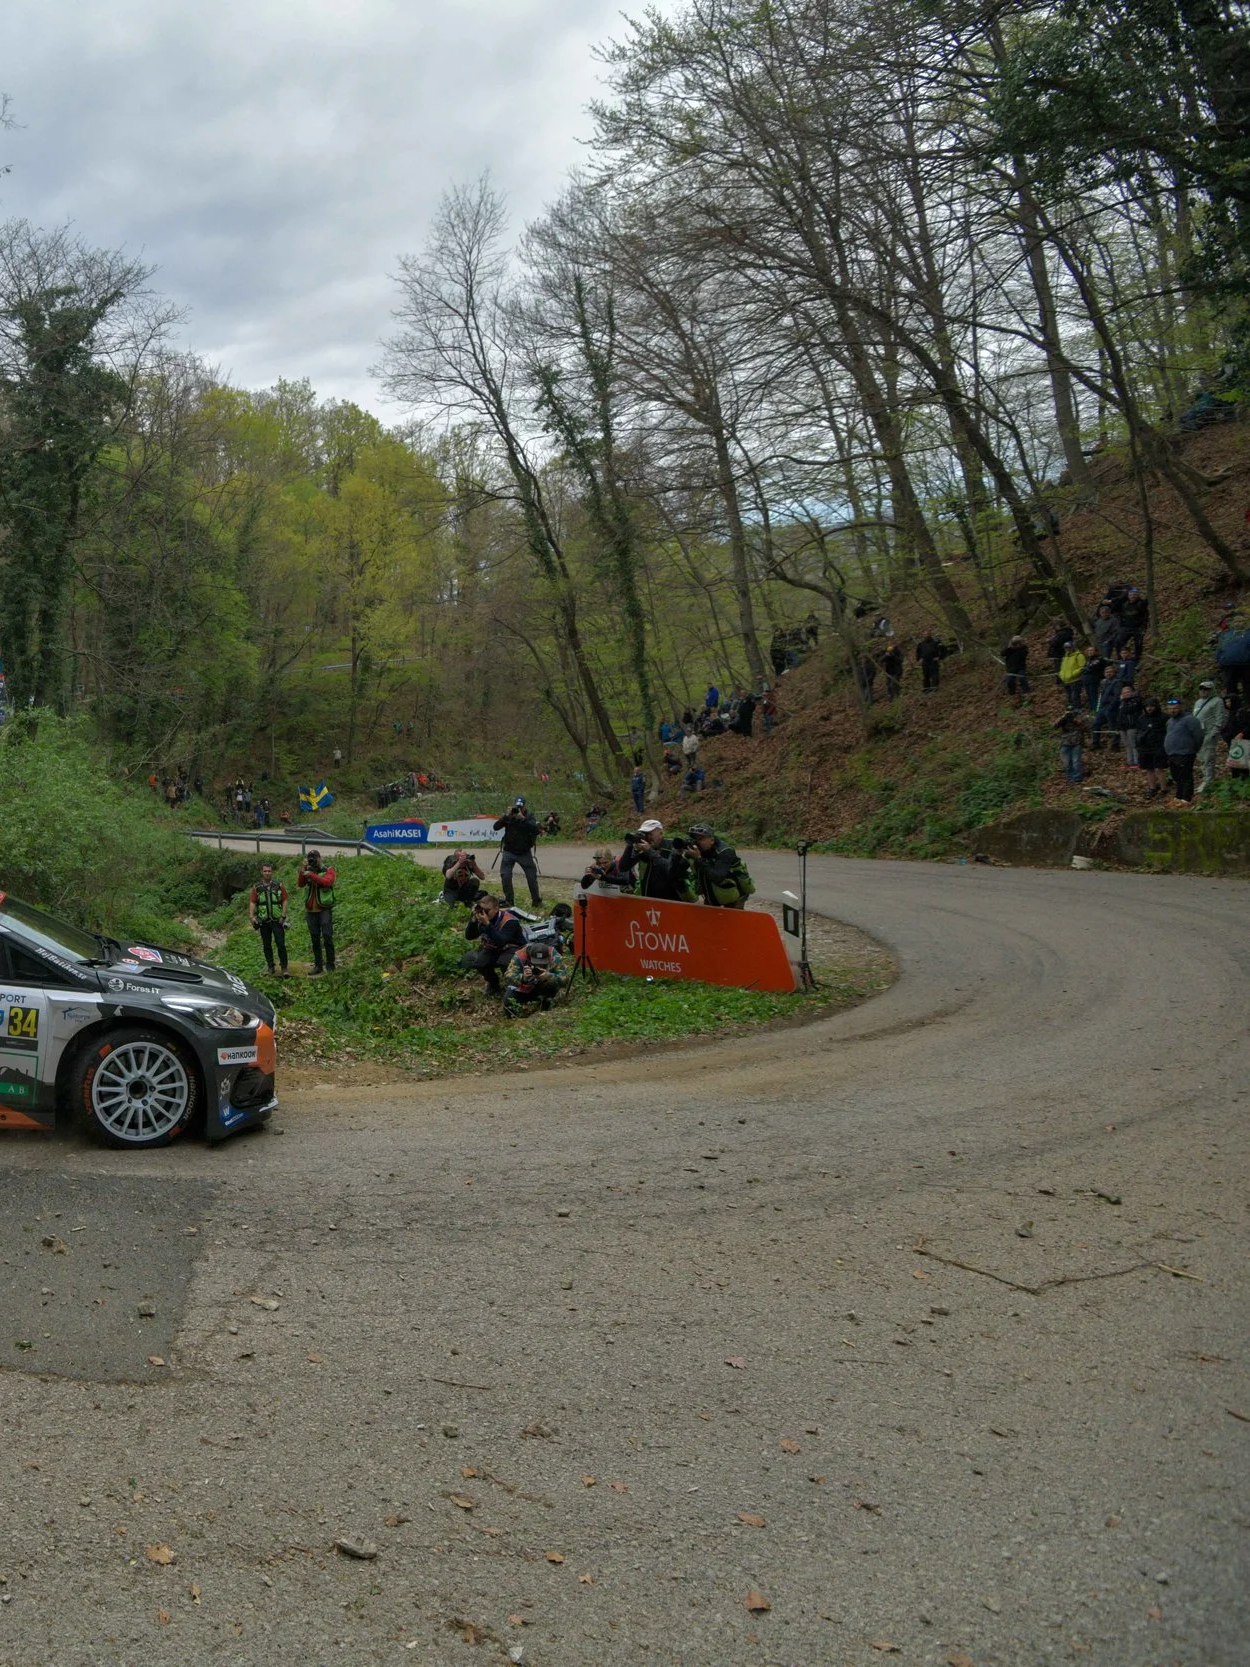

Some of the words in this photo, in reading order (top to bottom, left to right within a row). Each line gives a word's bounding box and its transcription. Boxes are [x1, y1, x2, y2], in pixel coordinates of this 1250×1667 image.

[639, 958, 682, 973] WATCHES
[126, 982, 150, 993] Forss
[150, 986, 160, 995] IT
[9, 1007, 37, 1038] 34
[8, 1084, 26, 1095] AB
